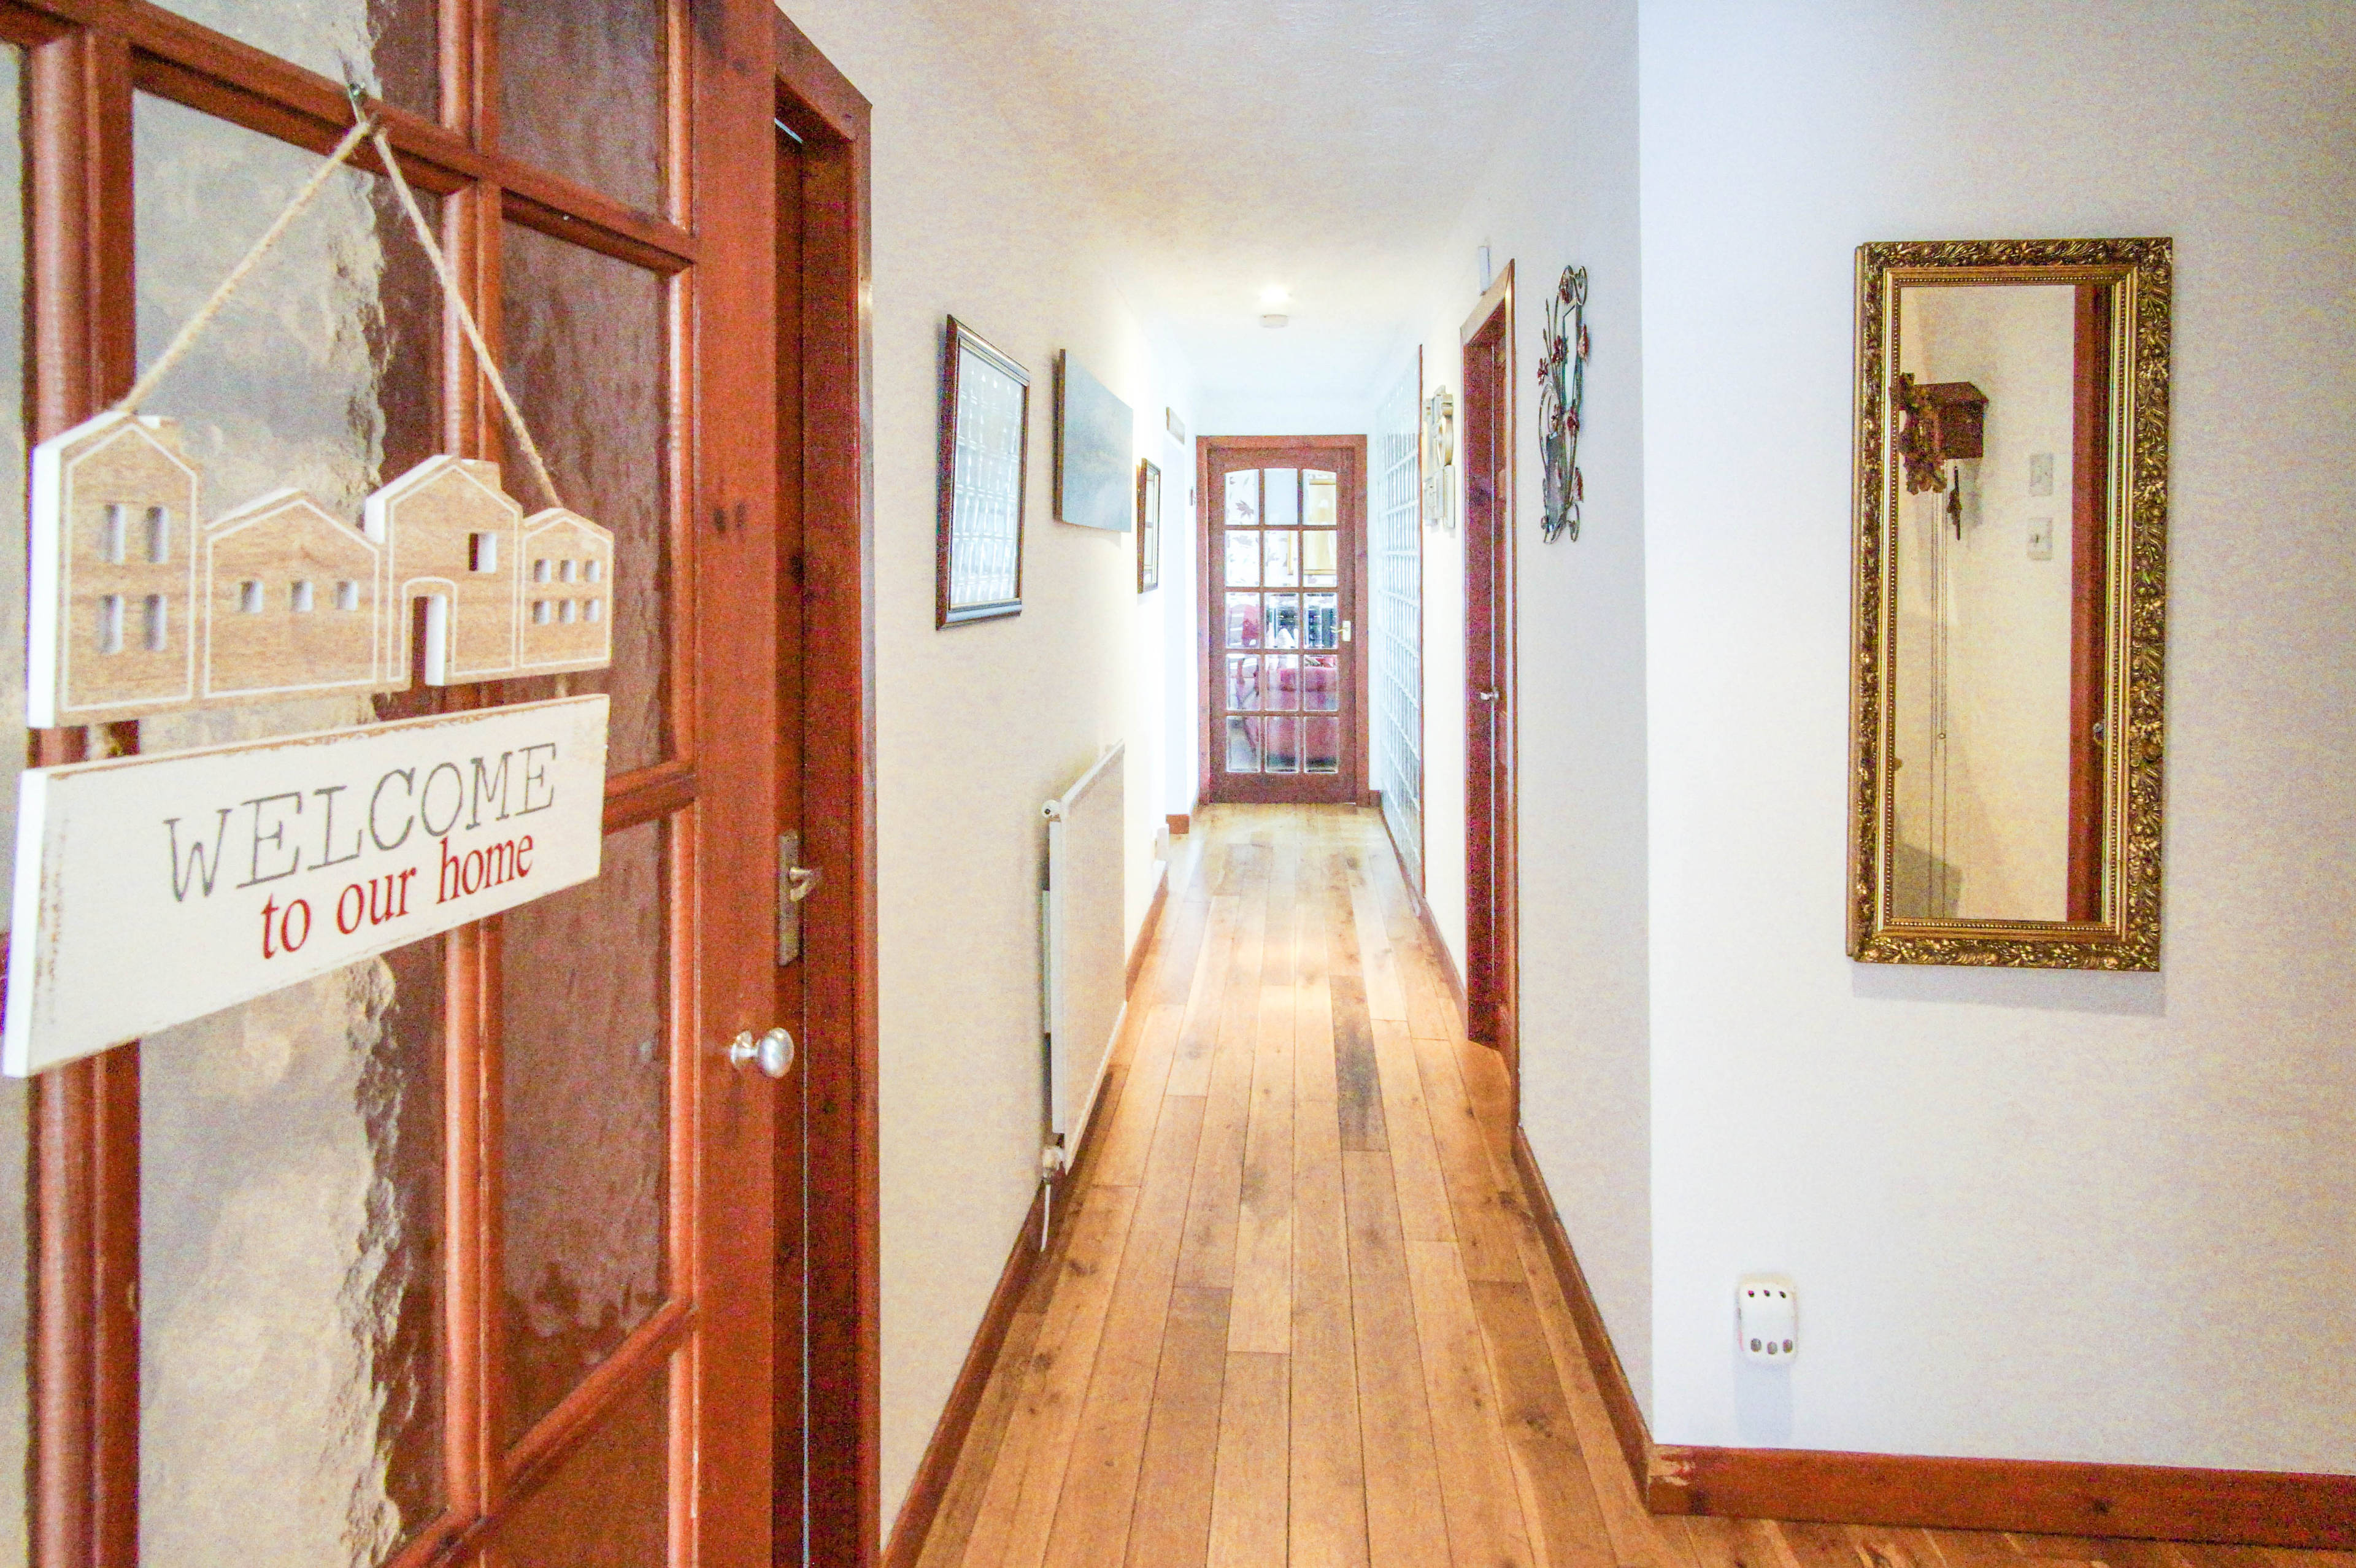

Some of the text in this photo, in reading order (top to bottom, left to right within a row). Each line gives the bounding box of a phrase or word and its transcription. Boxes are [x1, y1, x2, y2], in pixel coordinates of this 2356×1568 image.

[164, 742, 557, 902] WELCOME
[261, 834, 534, 959] to our home
